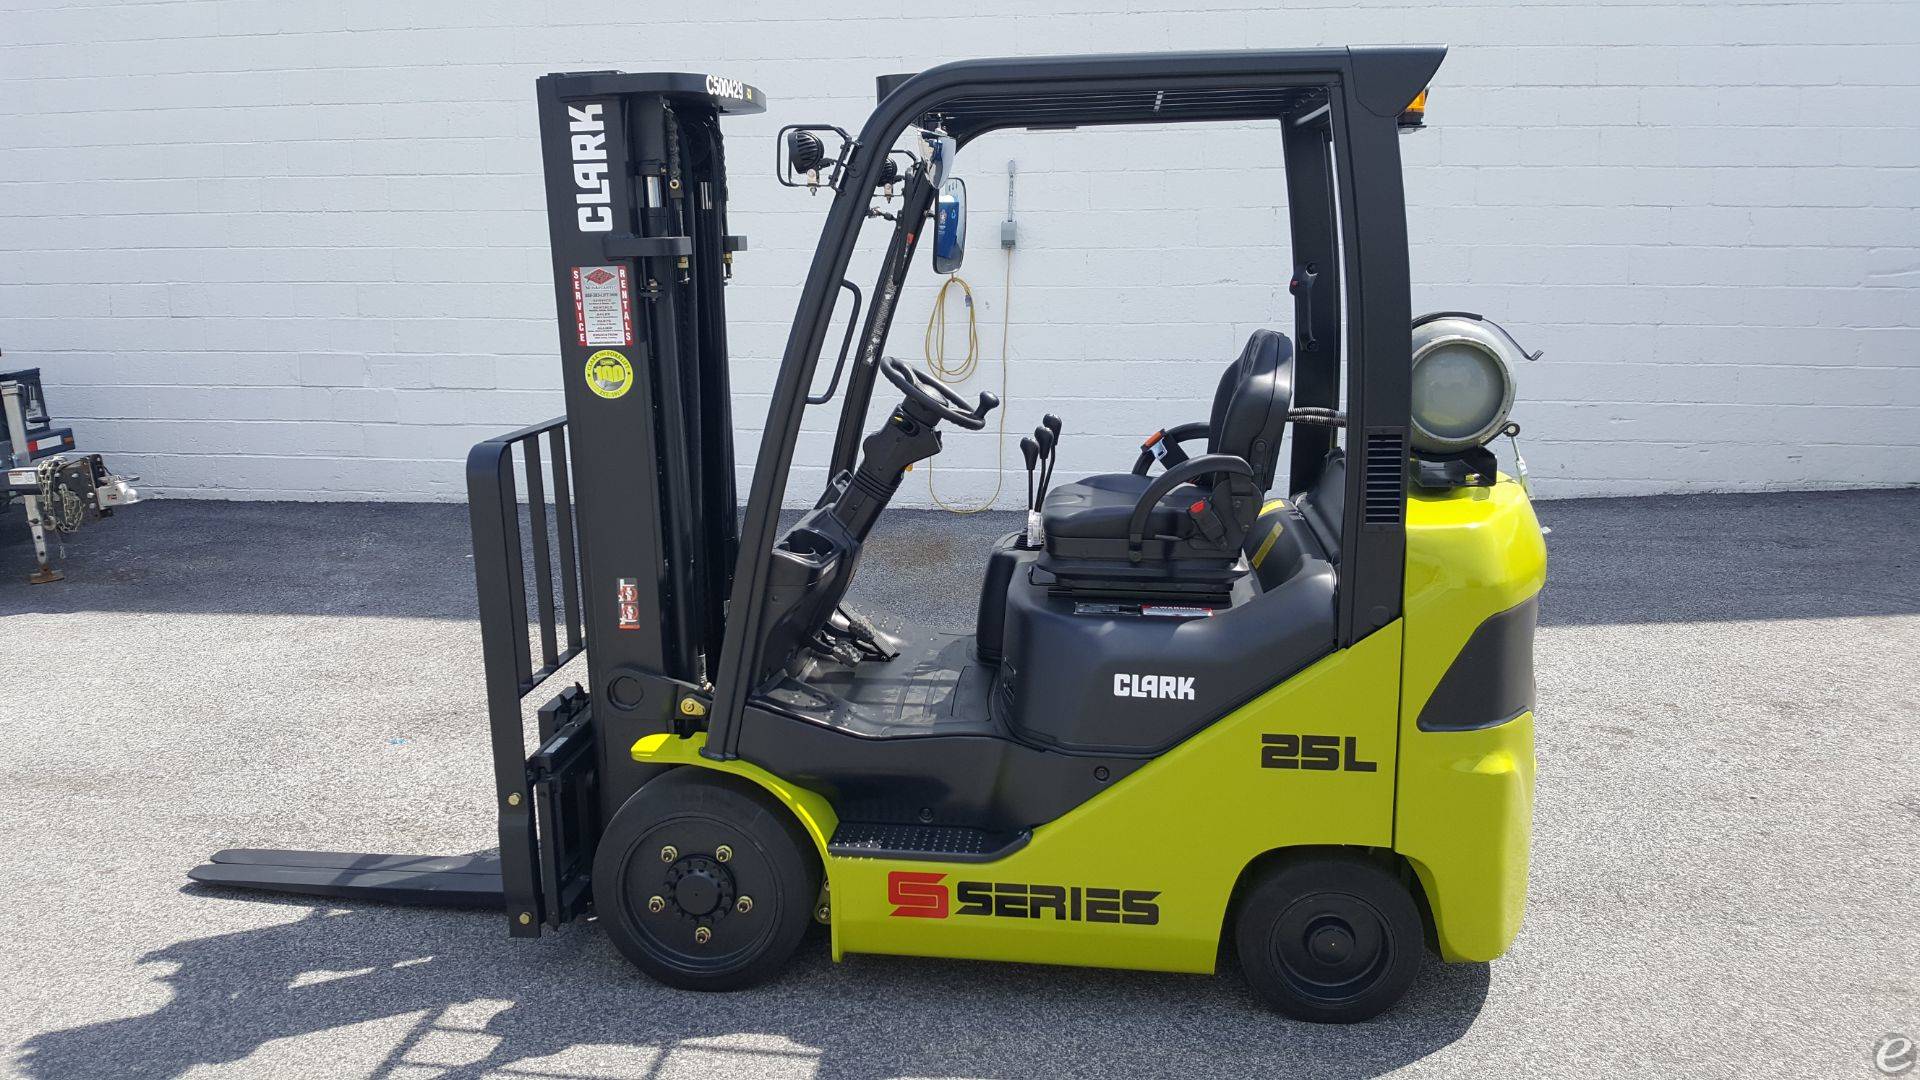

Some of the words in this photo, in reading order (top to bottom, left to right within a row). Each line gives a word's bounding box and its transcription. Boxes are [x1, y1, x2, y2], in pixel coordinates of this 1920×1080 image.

[705, 74, 744, 100] C500429
[567, 103, 613, 232] CLARK
[573, 270, 586, 342] SERVICE
[619, 269, 631, 341] RENTALS
[1113, 673, 1196, 701] CLARK
[1261, 733, 1378, 773] 25L
[887, 870, 949, 920] S
[954, 881, 1163, 926] SERIES
